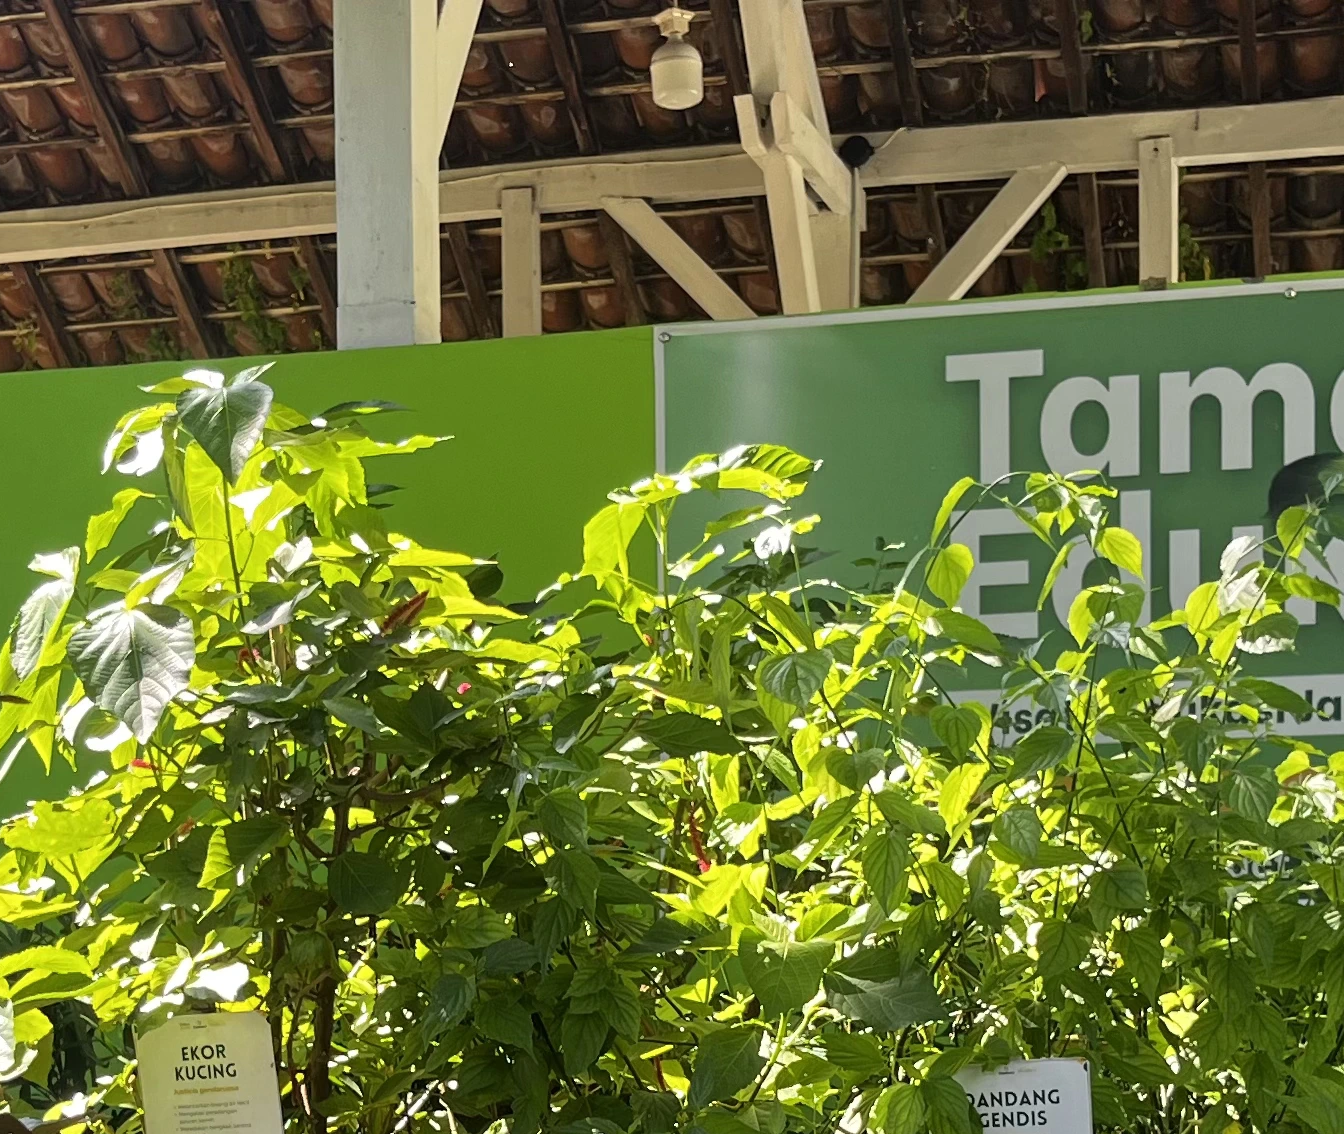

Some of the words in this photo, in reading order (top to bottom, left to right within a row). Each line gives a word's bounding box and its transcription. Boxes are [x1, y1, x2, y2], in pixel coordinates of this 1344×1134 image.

[181, 1043, 227, 1062] EKOR
[174, 1062, 237, 1081] KUCING
[979, 1110, 1048, 1128] GENDIS
